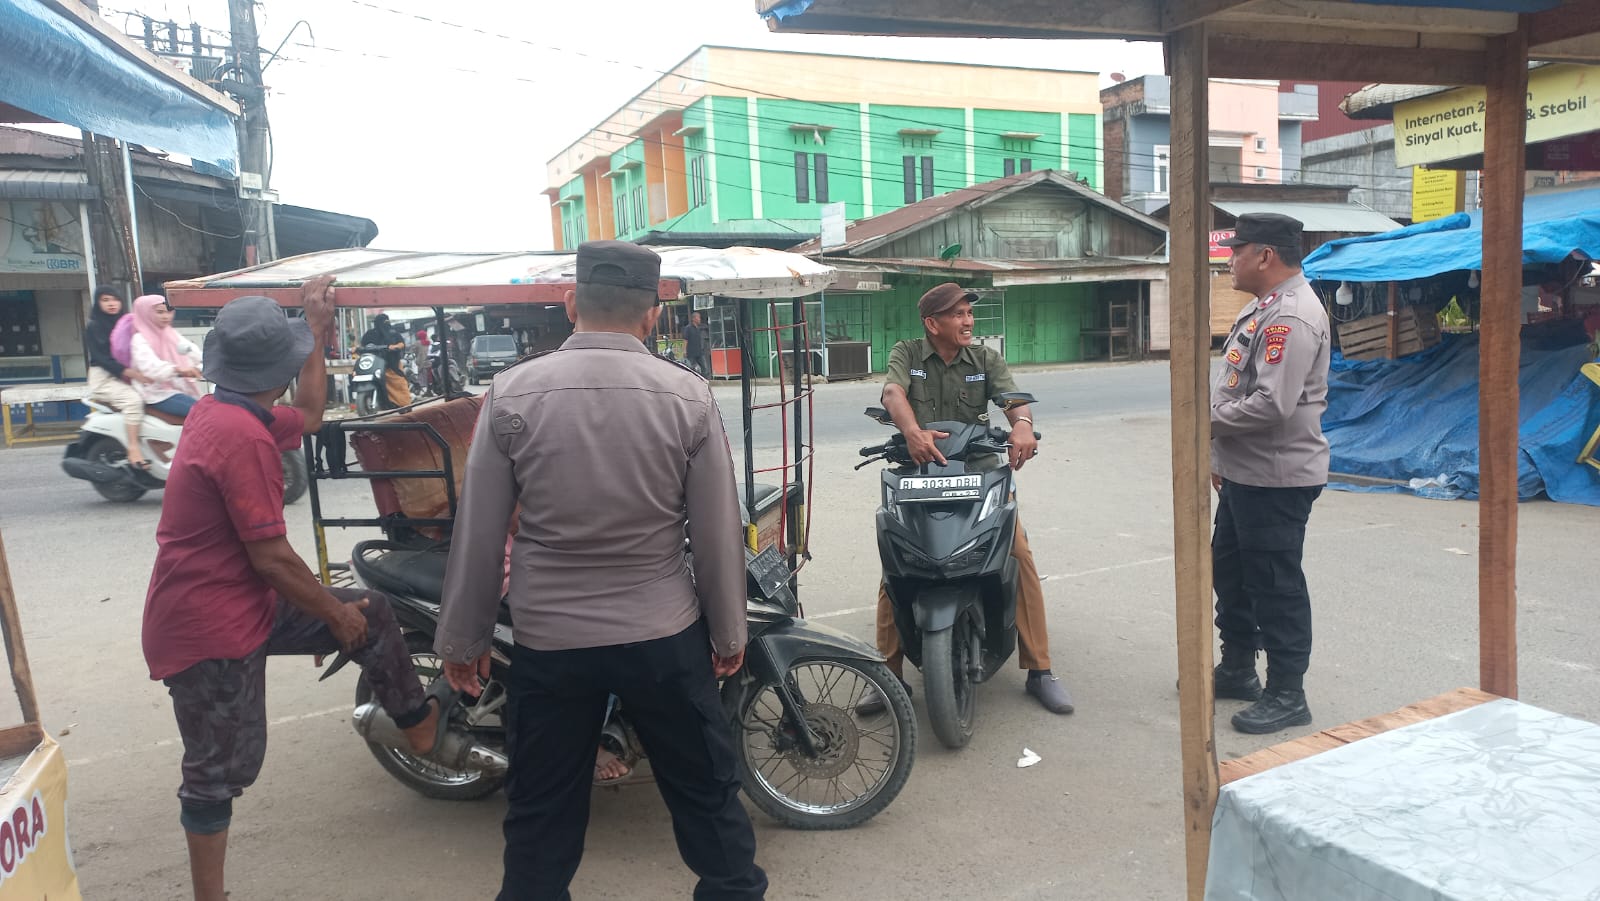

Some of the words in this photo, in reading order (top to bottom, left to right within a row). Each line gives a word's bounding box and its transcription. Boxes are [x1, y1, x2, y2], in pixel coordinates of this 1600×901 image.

[1405, 105, 1475, 130] Internetan
[1477, 100, 1486, 113] 2
[1405, 127, 1444, 147] Sinyal
[1525, 108, 1536, 121] &
[1539, 95, 1587, 118] Stabil
[60, 259, 80, 269] BRI
[921, 479, 952, 489] 3033
[0, 796, 45, 880] ORA
